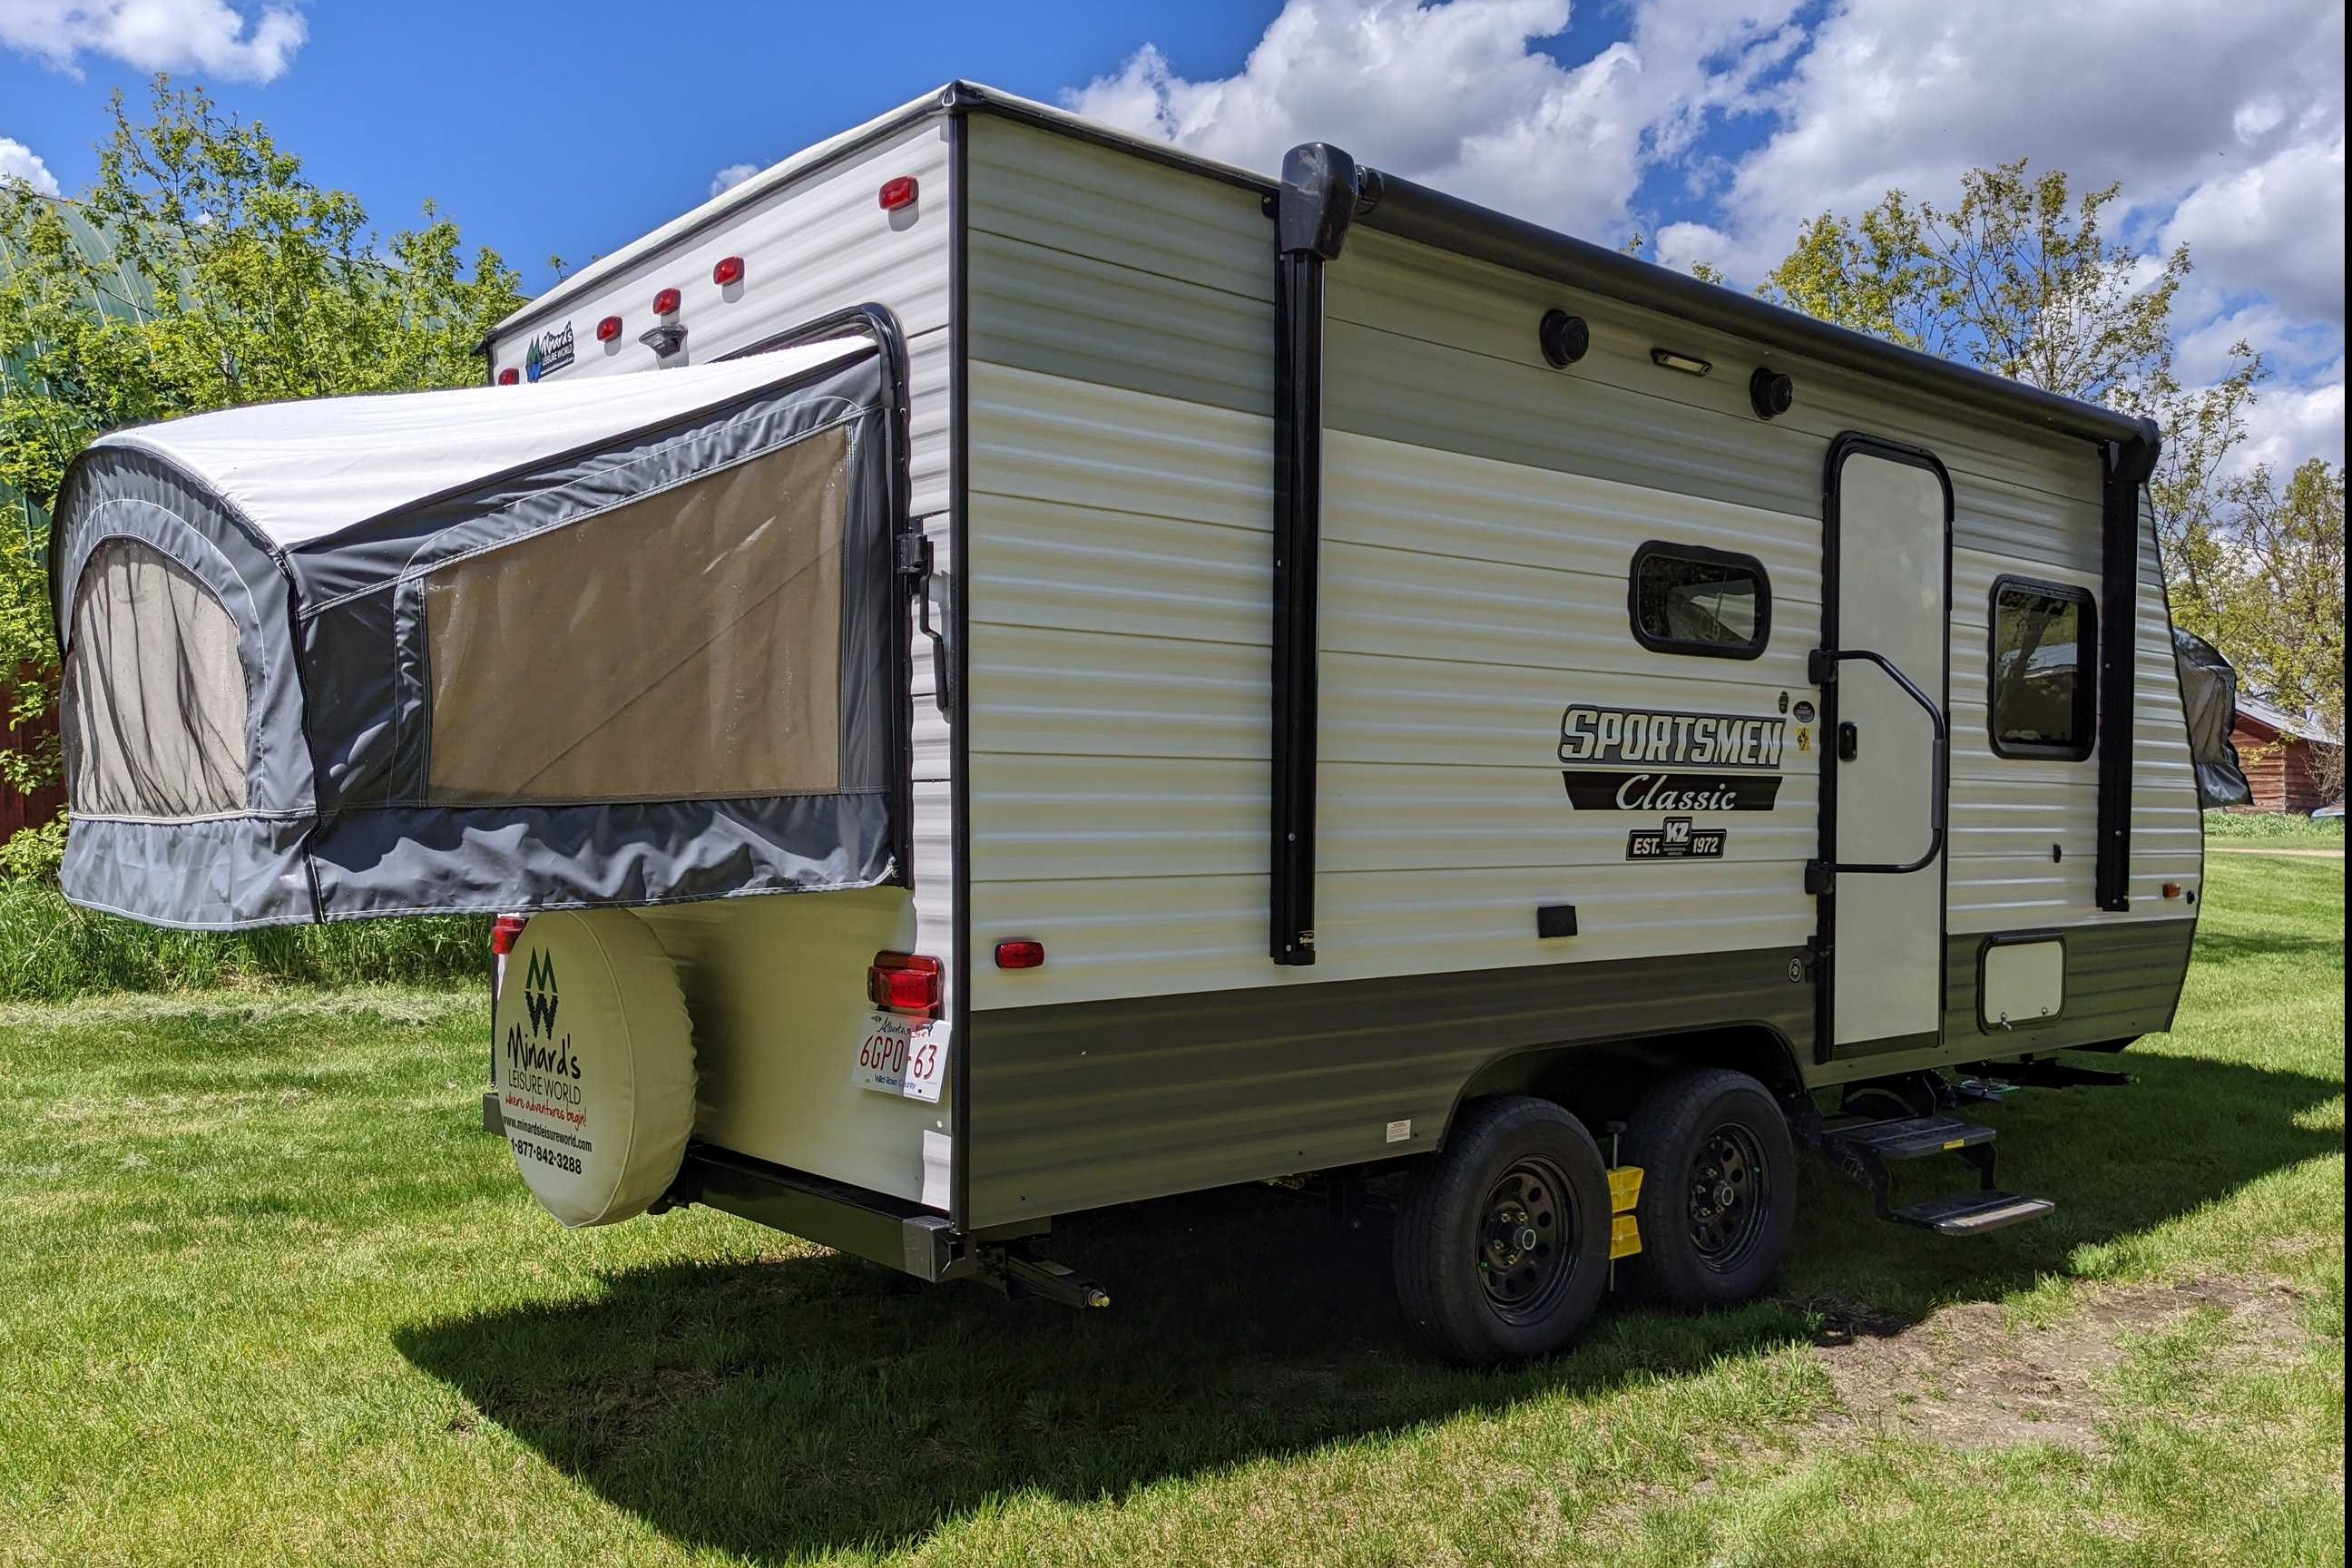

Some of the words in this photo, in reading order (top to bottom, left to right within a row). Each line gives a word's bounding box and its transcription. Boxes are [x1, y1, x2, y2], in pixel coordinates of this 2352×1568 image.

[1561, 709, 1784, 767] SPORTSMEN
[1616, 774, 1737, 810] Classic
[1632, 838, 1661, 854] EST.
[1692, 837, 1719, 853] 1972
[1666, 822, 1690, 843] KZ
[507, 1022, 582, 1080] Minard's
[508, 1069, 543, 1095] LEISURE
[544, 1078, 581, 1105] WORLD
[505, 1092, 526, 1108] where
[526, 1095, 564, 1121] adventures
[566, 1102, 588, 1132] begin!
[504, 1115, 593, 1152] www.minardsleisureworld.com
[511, 1136, 582, 1175] 1-877-842-3288
